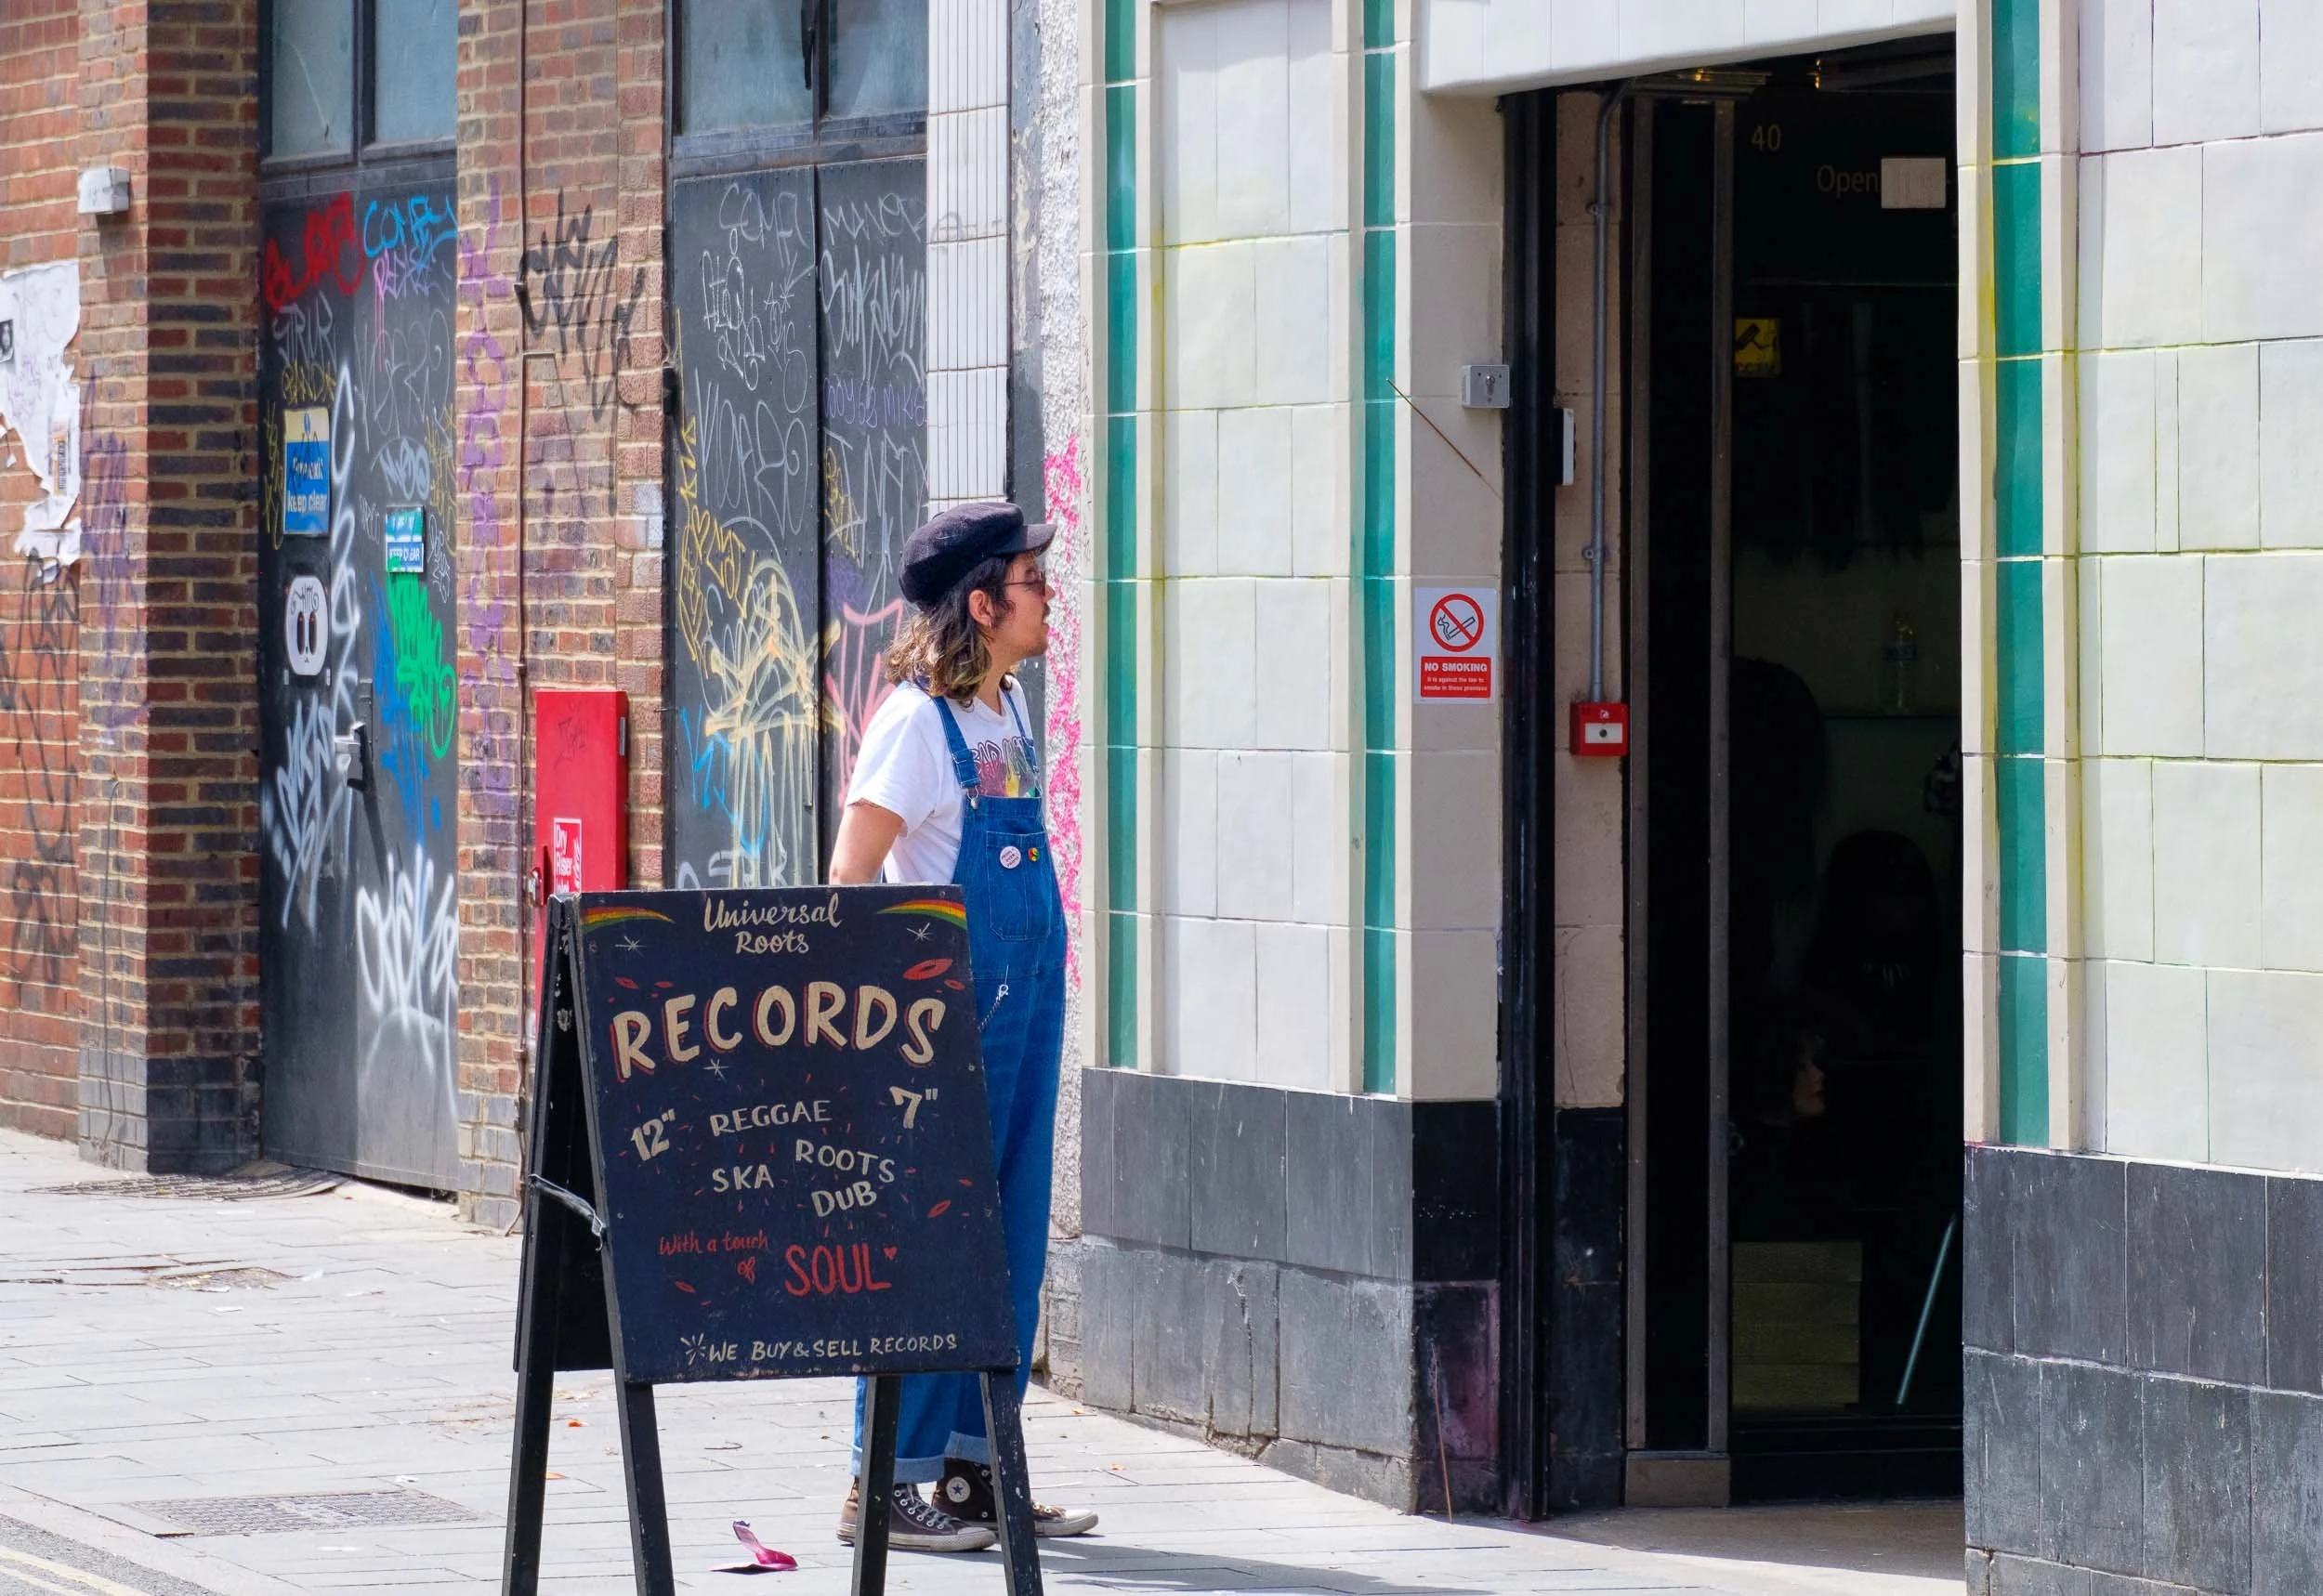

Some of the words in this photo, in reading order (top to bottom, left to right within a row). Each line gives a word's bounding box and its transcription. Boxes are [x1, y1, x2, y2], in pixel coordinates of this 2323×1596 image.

[1751, 124, 1782, 152] 40
[1816, 164, 1879, 199] Open
[287, 491, 308, 517] keep
[308, 491, 327, 513] clear
[1424, 662, 1439, 672] NO
[1441, 662, 1488, 673] SMOKING
[557, 824, 568, 856] Dry
[557, 851, 573, 876] Riser
[704, 892, 843, 933] Universal
[735, 931, 809, 955] Roots
[610, 981, 946, 1081] RECORDS
[710, 1100, 832, 1136] REGGAE
[889, 1085, 938, 1130] 7"
[631, 1108, 676, 1161] 12"
[795, 1139, 896, 1184] ROOTS
[712, 1164, 774, 1193] SKA
[811, 1181, 877, 1218] DUB
[707, 1238, 717, 1253] a
[722, 1229, 769, 1252] touch
[737, 1256, 756, 1285] of
[784, 1242, 892, 1297] SOUL
[709, 1341, 738, 1363] WE
[870, 1333, 958, 1354] RECORDS
